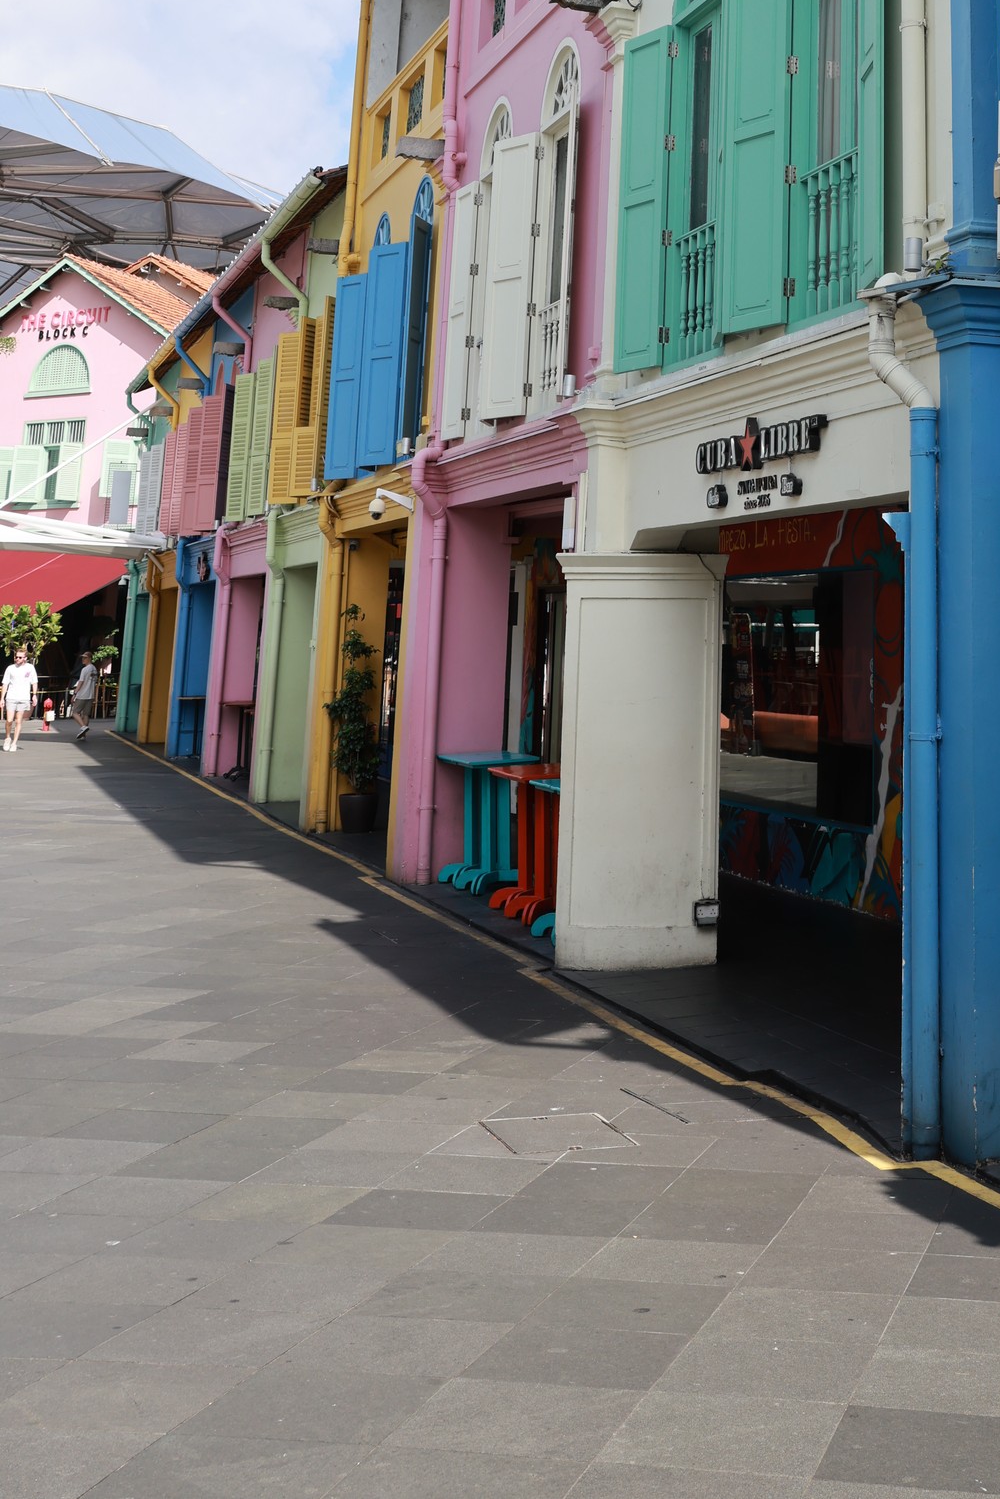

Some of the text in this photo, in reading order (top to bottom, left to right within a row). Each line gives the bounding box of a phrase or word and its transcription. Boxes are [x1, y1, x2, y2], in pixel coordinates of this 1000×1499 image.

[21, 305, 111, 333] THE CIRCUIT
[38, 326, 89, 342] BLOCK C
[696, 437, 738, 474] CUBA
[780, 476, 794, 494] Bar
